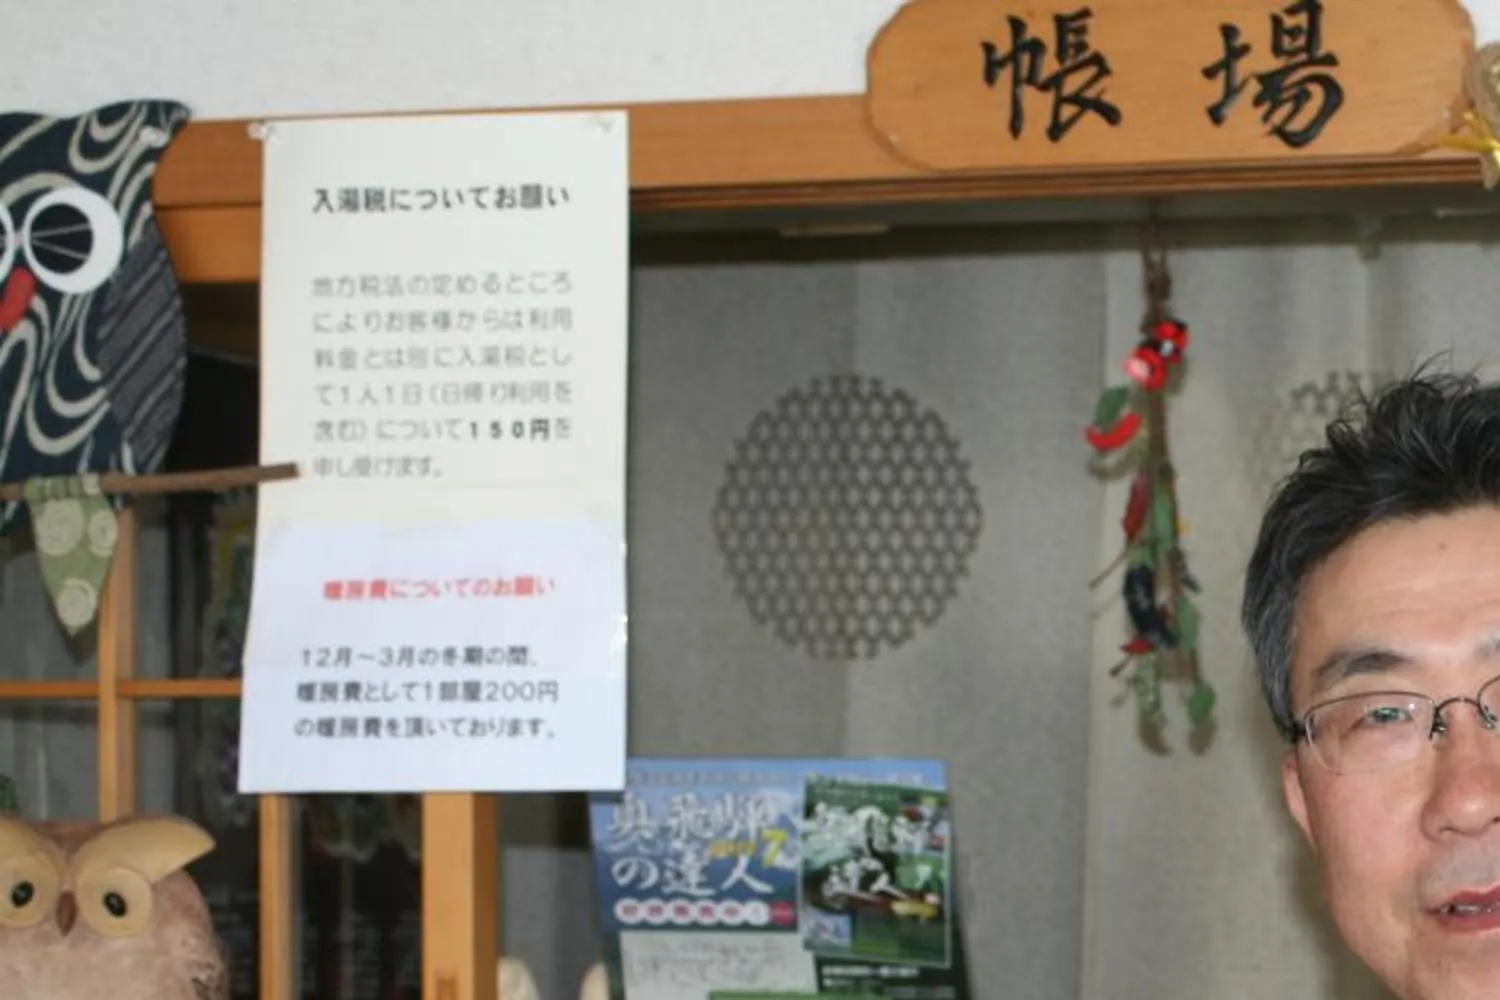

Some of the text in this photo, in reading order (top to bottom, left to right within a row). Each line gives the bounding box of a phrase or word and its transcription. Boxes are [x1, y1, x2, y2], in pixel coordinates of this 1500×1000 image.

[980, 0, 1344, 148] 帳場
[312, 184, 571, 214] 入湯税についてお願い
[312, 271, 573, 299] 地方税法の定めるところ
[312, 308, 573, 334] によりお客様からは利用
[312, 344, 573, 371] 料金とは別に入湯税とし
[323, 575, 556, 602] 暖房費についてのお願い
